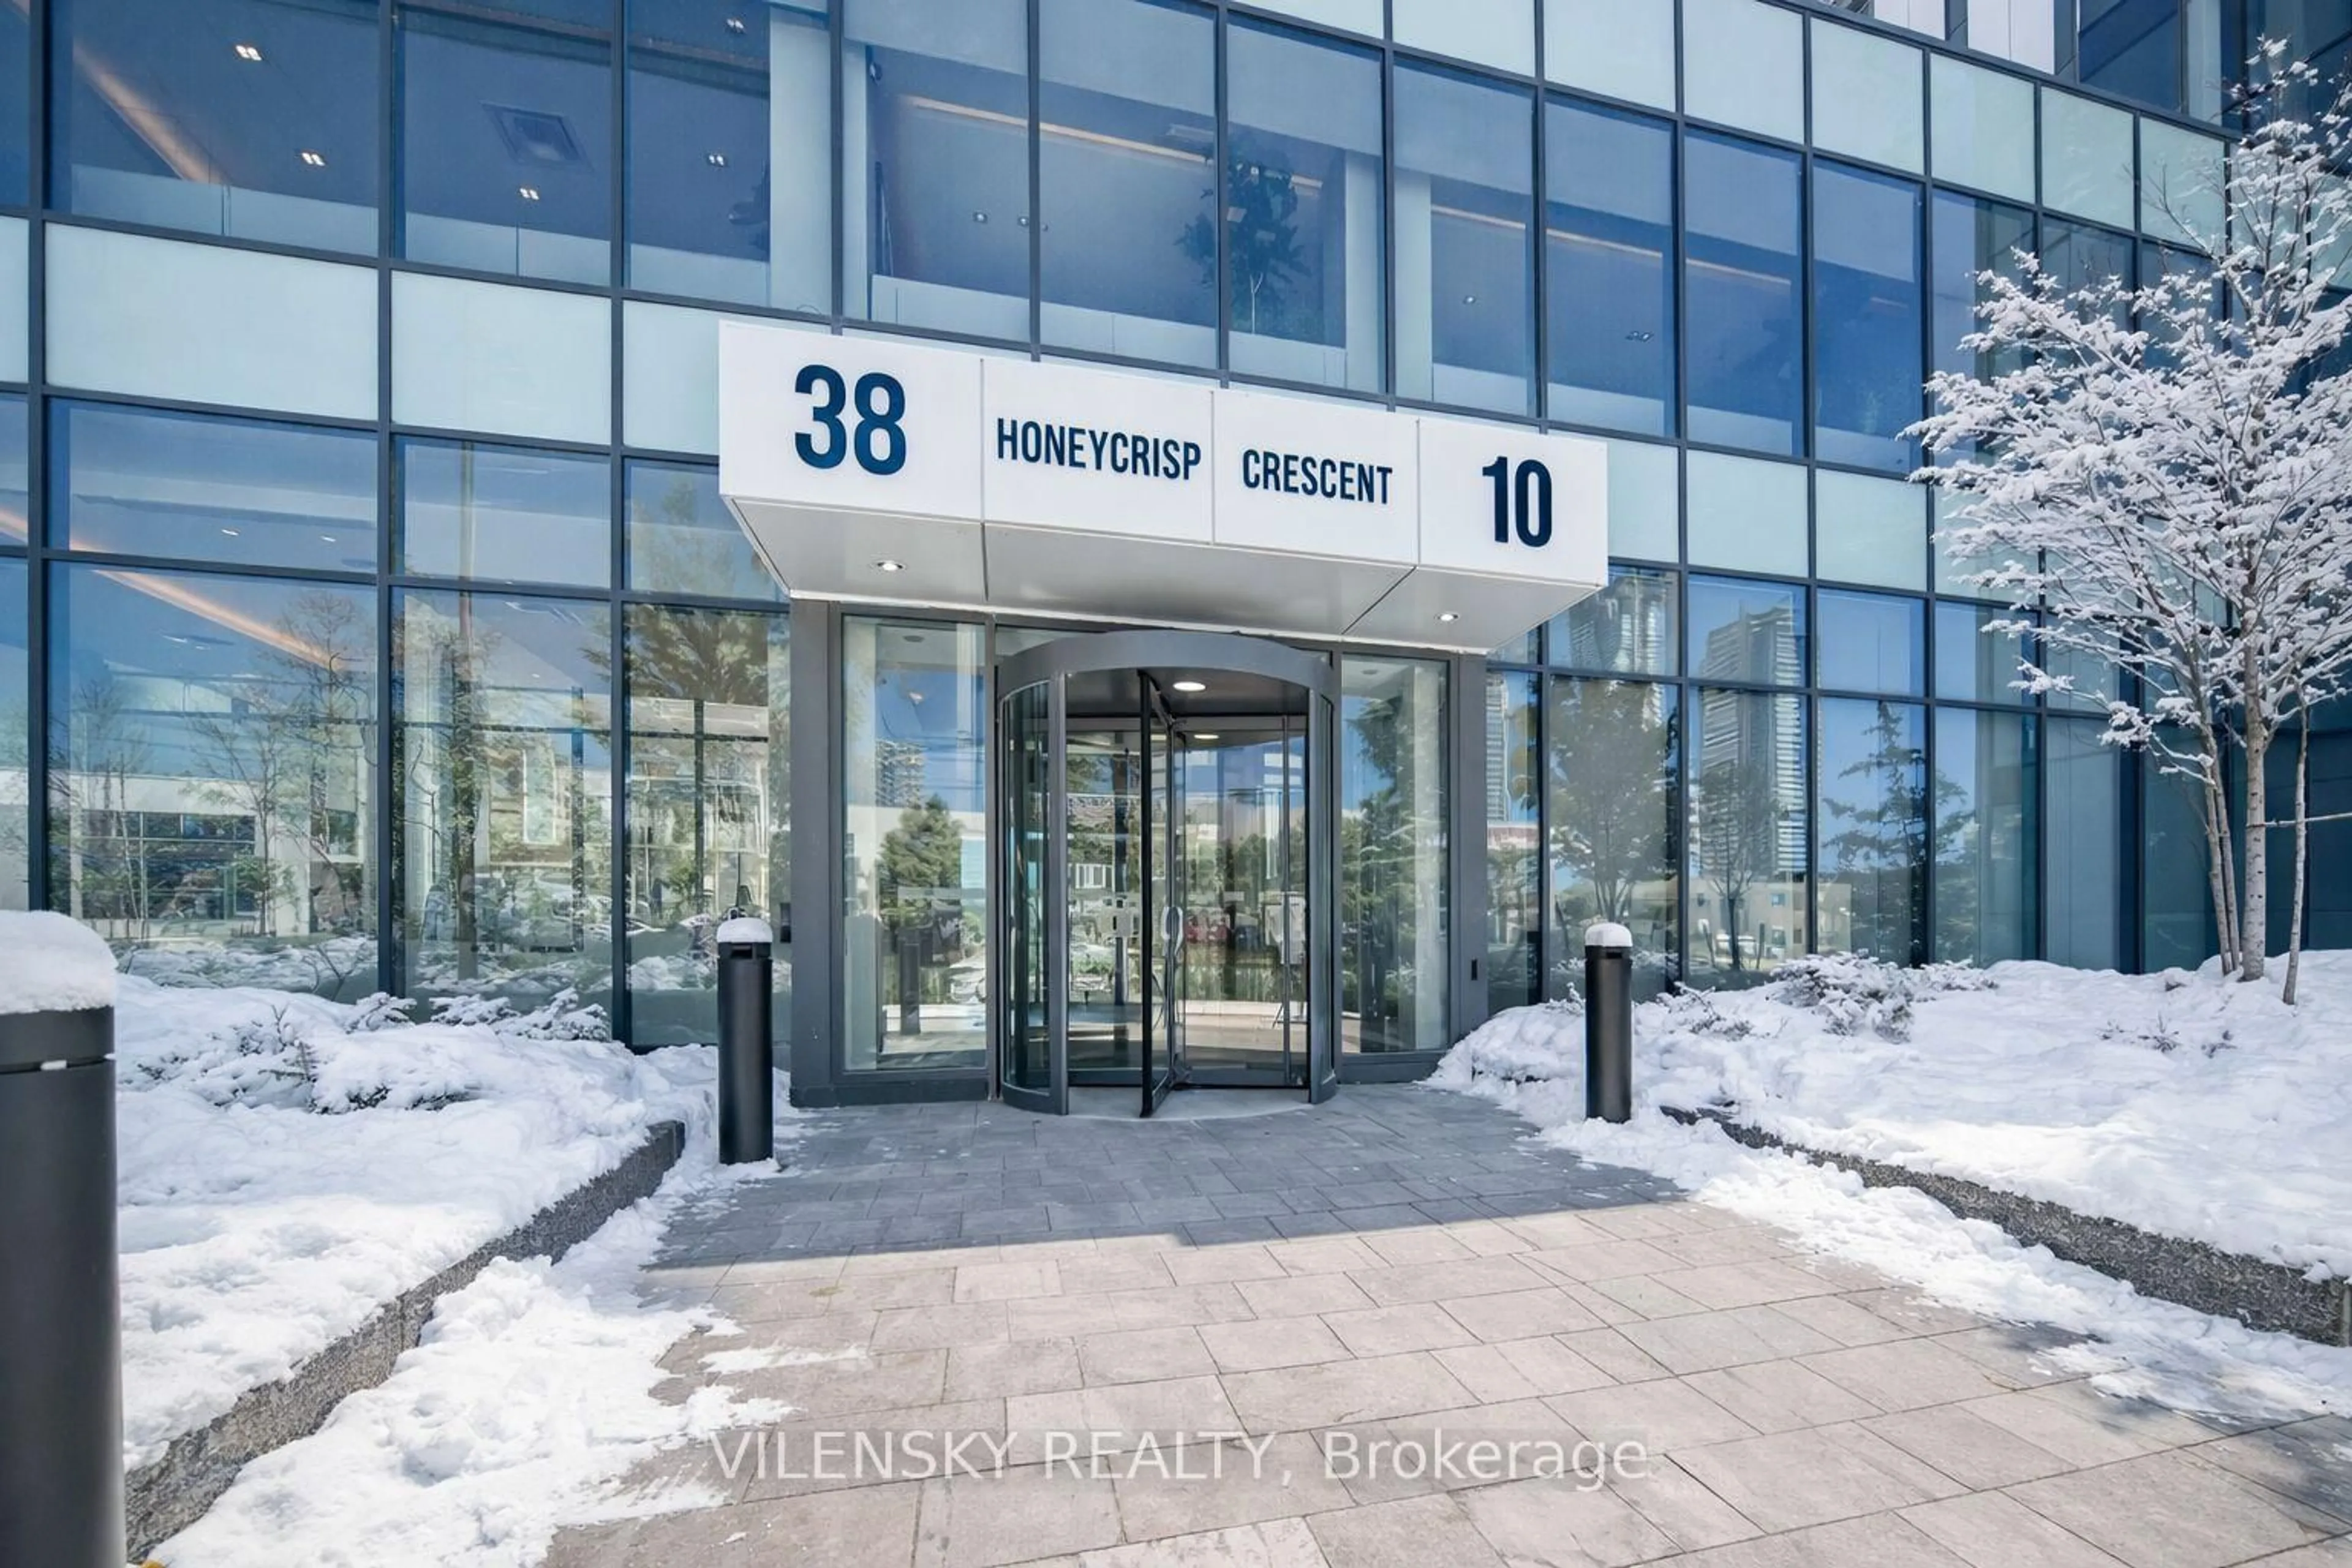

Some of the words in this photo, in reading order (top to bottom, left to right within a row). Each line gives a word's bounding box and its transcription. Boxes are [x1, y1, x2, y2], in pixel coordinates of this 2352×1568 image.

[794, 363, 907, 476] 38
[997, 417, 1201, 481] HONEYCRISP
[1242, 448, 1393, 505] CRESCENT
[1481, 455, 1553, 548] 10
